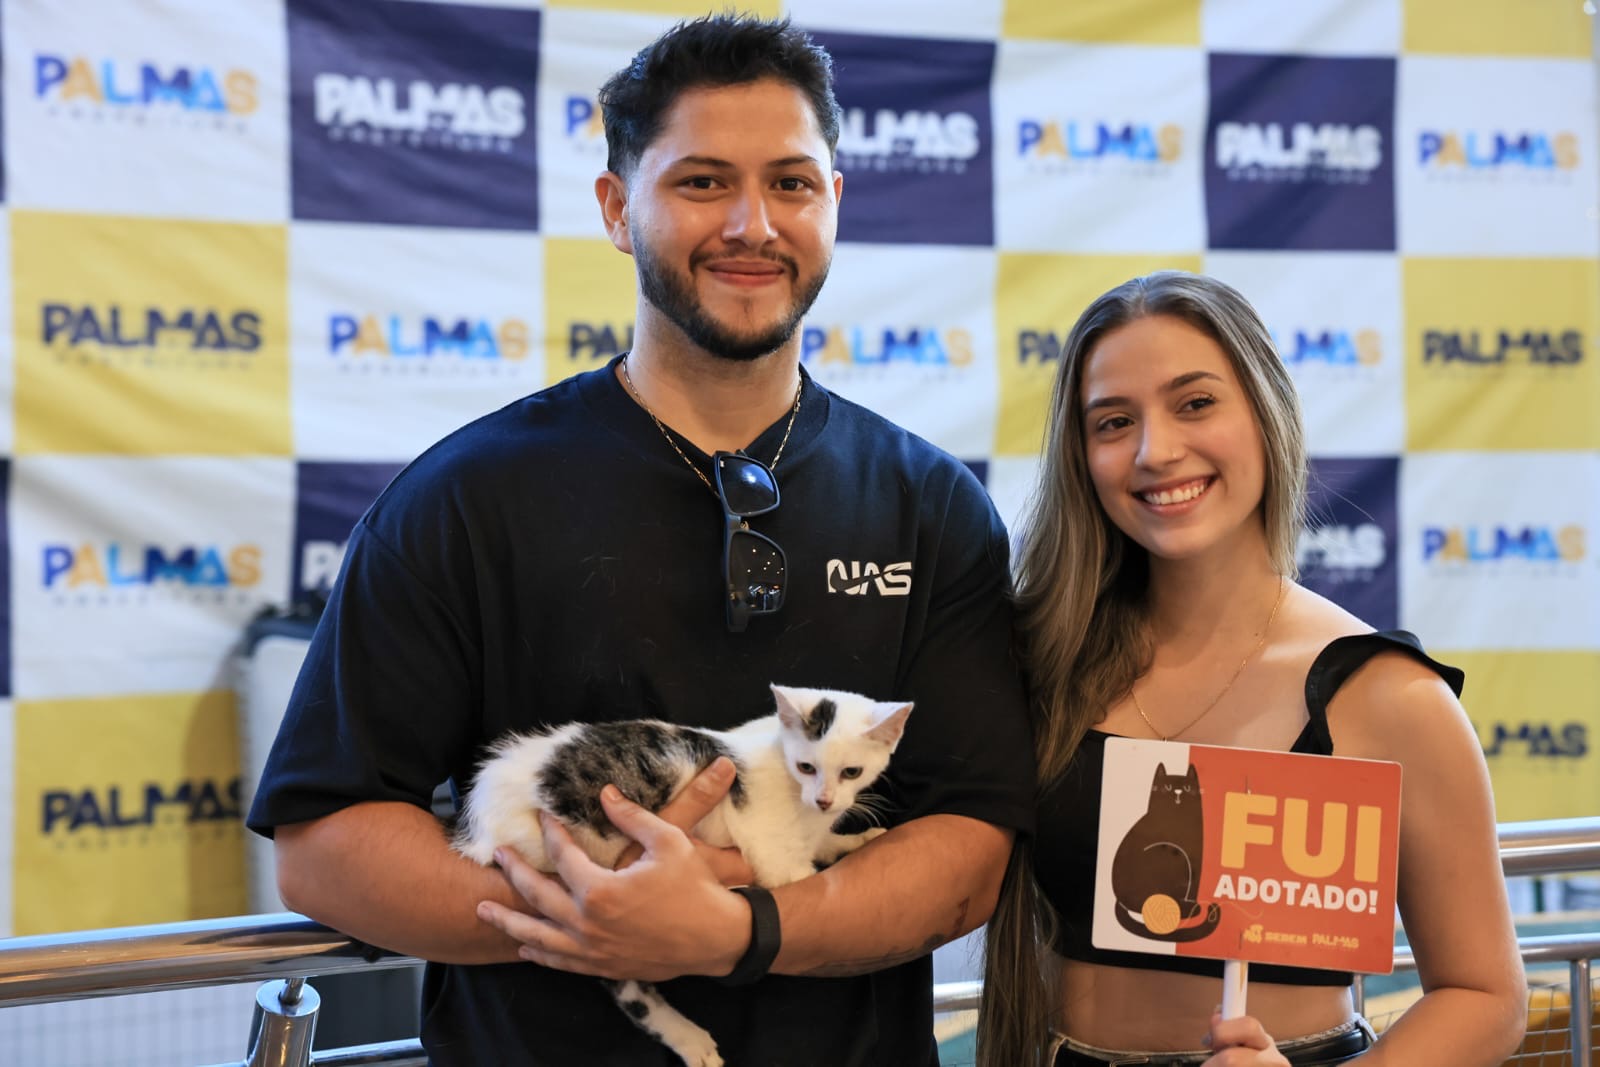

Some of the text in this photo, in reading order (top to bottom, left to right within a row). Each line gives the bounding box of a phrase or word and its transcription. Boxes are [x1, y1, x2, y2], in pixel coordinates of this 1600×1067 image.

[34, 54, 260, 116] PALMAS
[314, 73, 526, 138] PALMAS
[836, 107, 980, 160] LMAS
[1017, 119, 1183, 165] PALMAS
[1216, 121, 1382, 170] PALMAS
[1417, 129, 1580, 173] PALMAS
[42, 303, 263, 352] PALMAS
[328, 314, 529, 361] PALMAS
[802, 326, 974, 367] PALMAS
[1423, 329, 1583, 366] PALMAS
[42, 544, 263, 587] PALMAS
[1422, 526, 1584, 563] PALMAS
[1221, 792, 1382, 883] FUI
[1213, 874, 1379, 914] ADOTADO!
[1312, 933, 1359, 949] PALMAS
